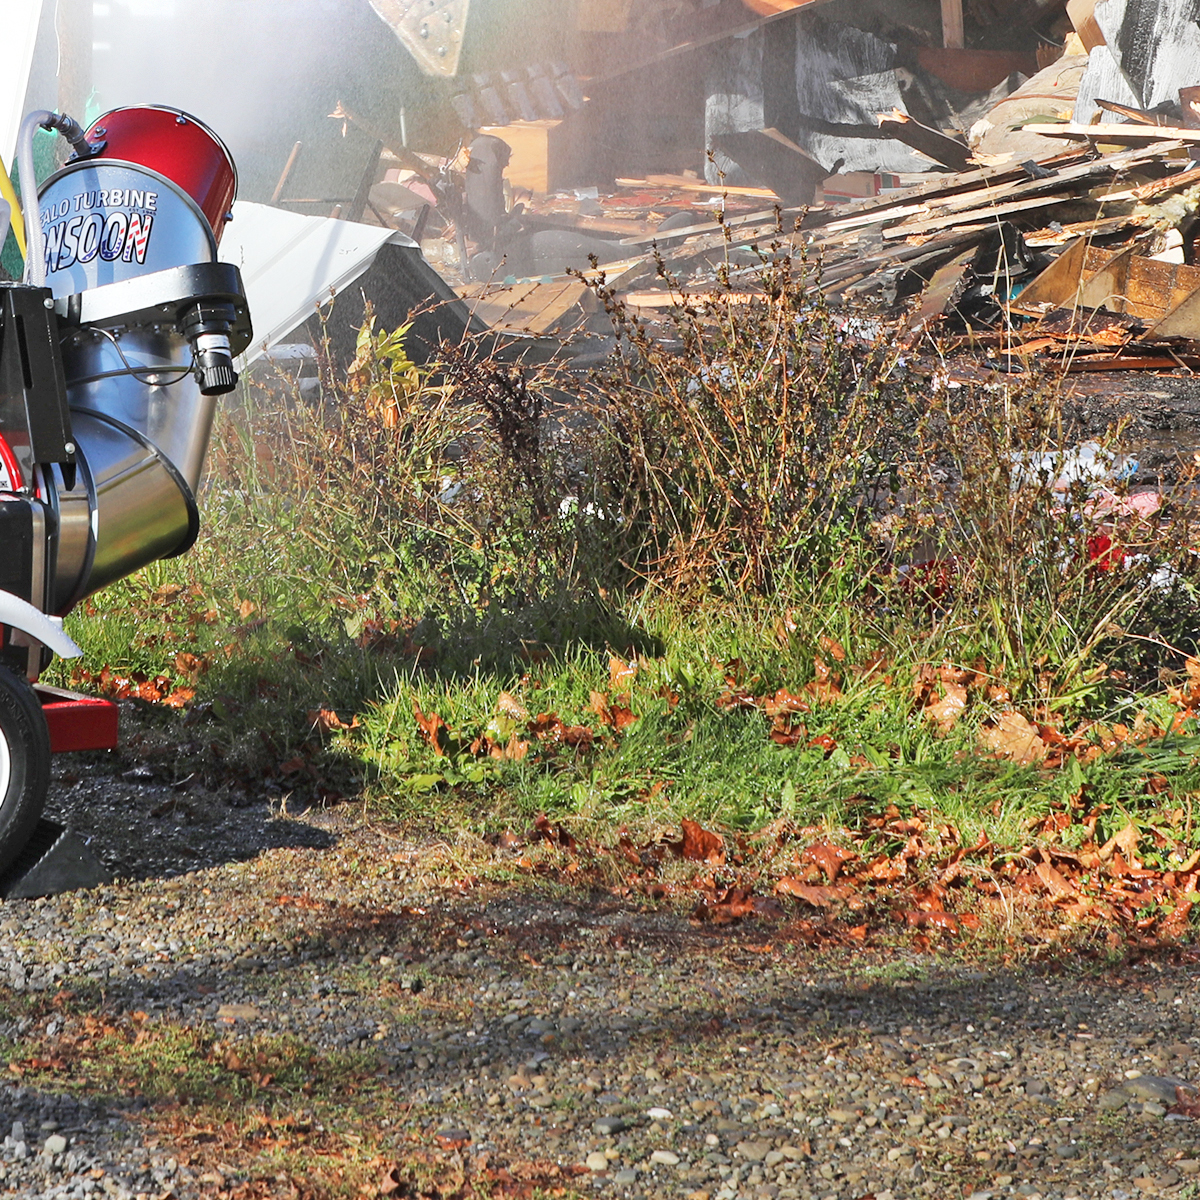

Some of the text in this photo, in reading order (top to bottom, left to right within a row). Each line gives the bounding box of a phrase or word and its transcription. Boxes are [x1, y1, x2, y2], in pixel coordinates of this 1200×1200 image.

[40, 189, 158, 227] FALO TURBINE
[42, 212, 153, 277] NSOON
